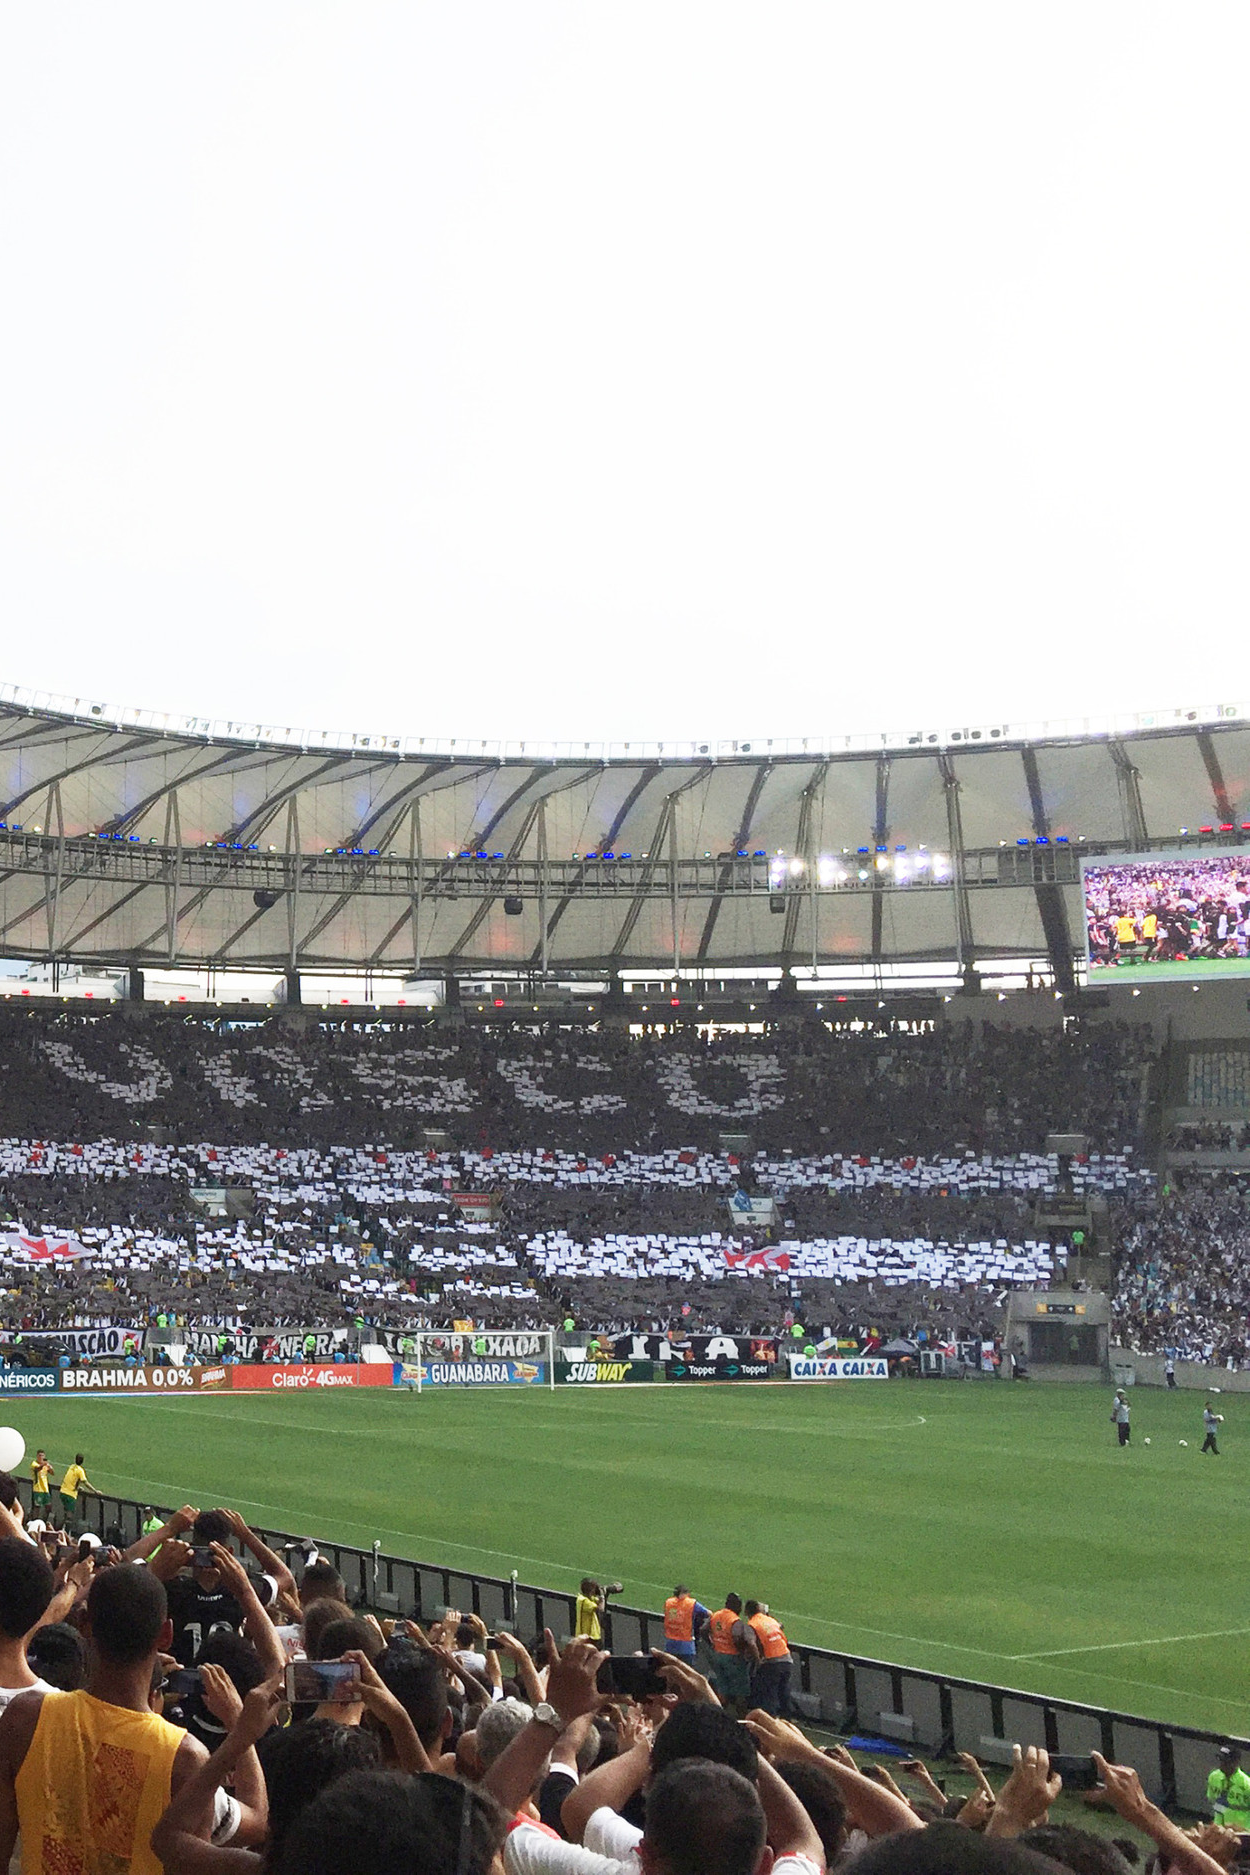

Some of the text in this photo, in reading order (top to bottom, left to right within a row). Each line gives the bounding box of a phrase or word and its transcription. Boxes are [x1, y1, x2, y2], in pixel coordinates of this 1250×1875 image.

[183, 1332, 340, 1359] MANHA NERA
[62, 1368, 194, 1388] BRAHMA 0,0%
[431, 1363, 510, 1383] GUANABARA
[565, 1362, 632, 1382] SUBWAY
[689, 1365, 717, 1376] Topper
[740, 1364, 768, 1375] Topper
[794, 1362, 887, 1376] CAIXA CAIXA
